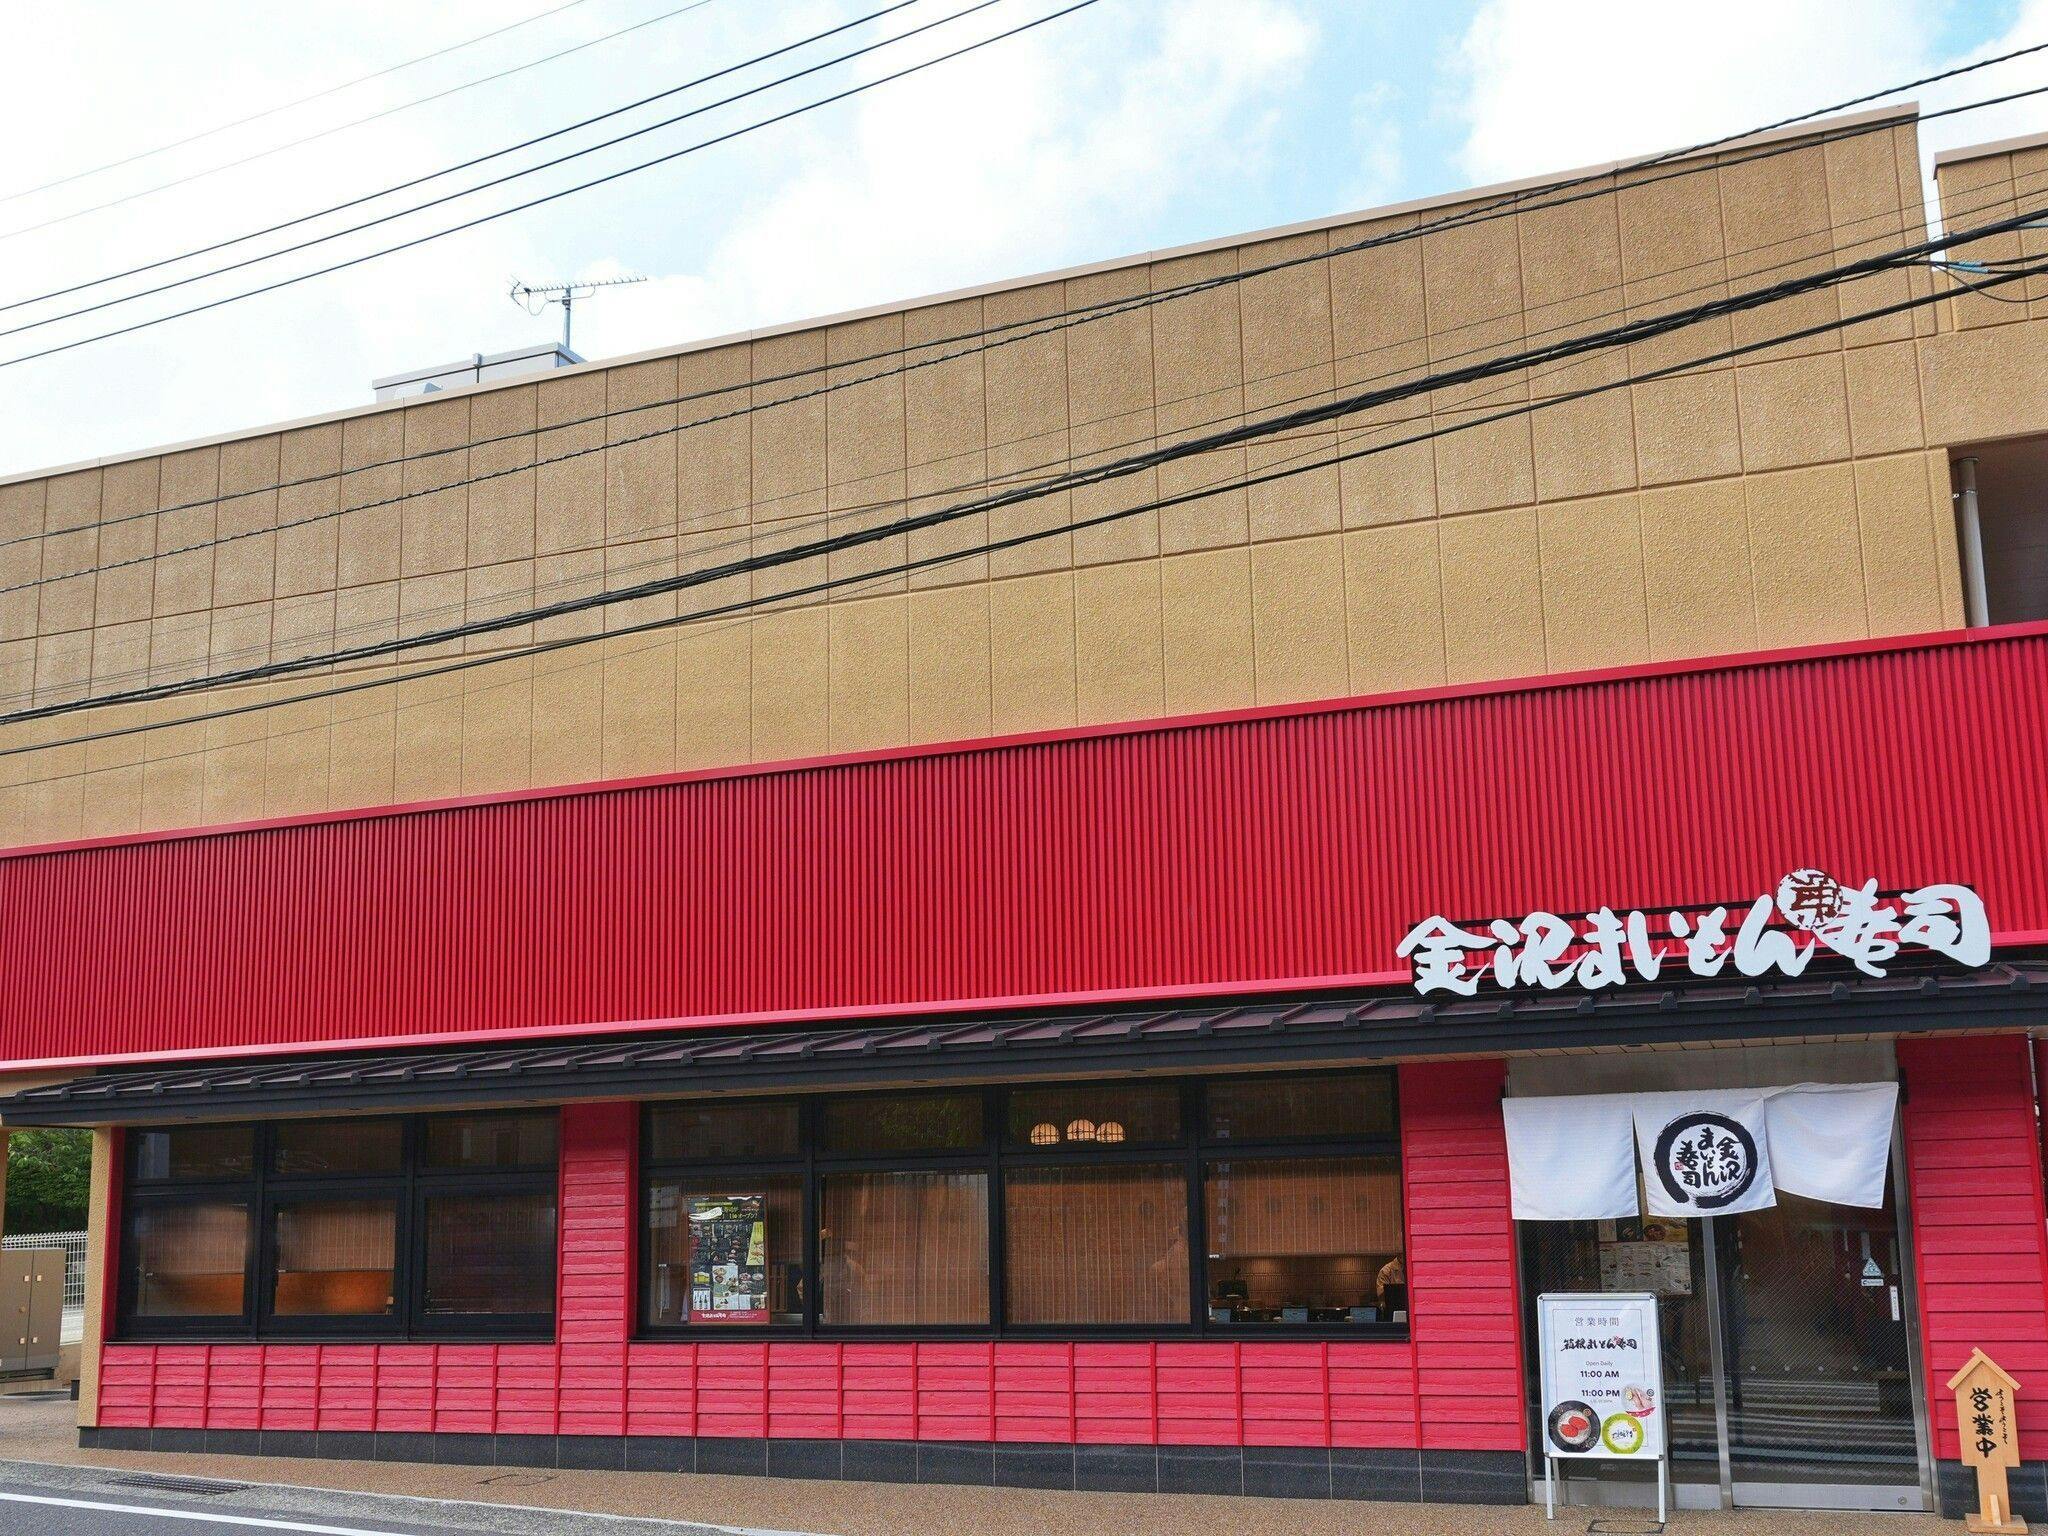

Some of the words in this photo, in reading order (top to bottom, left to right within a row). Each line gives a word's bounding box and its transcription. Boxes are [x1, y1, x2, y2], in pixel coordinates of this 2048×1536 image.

[1575, 1317, 1619, 1326] 営業時間
[1970, 1387, 1997, 1458] 営業中
